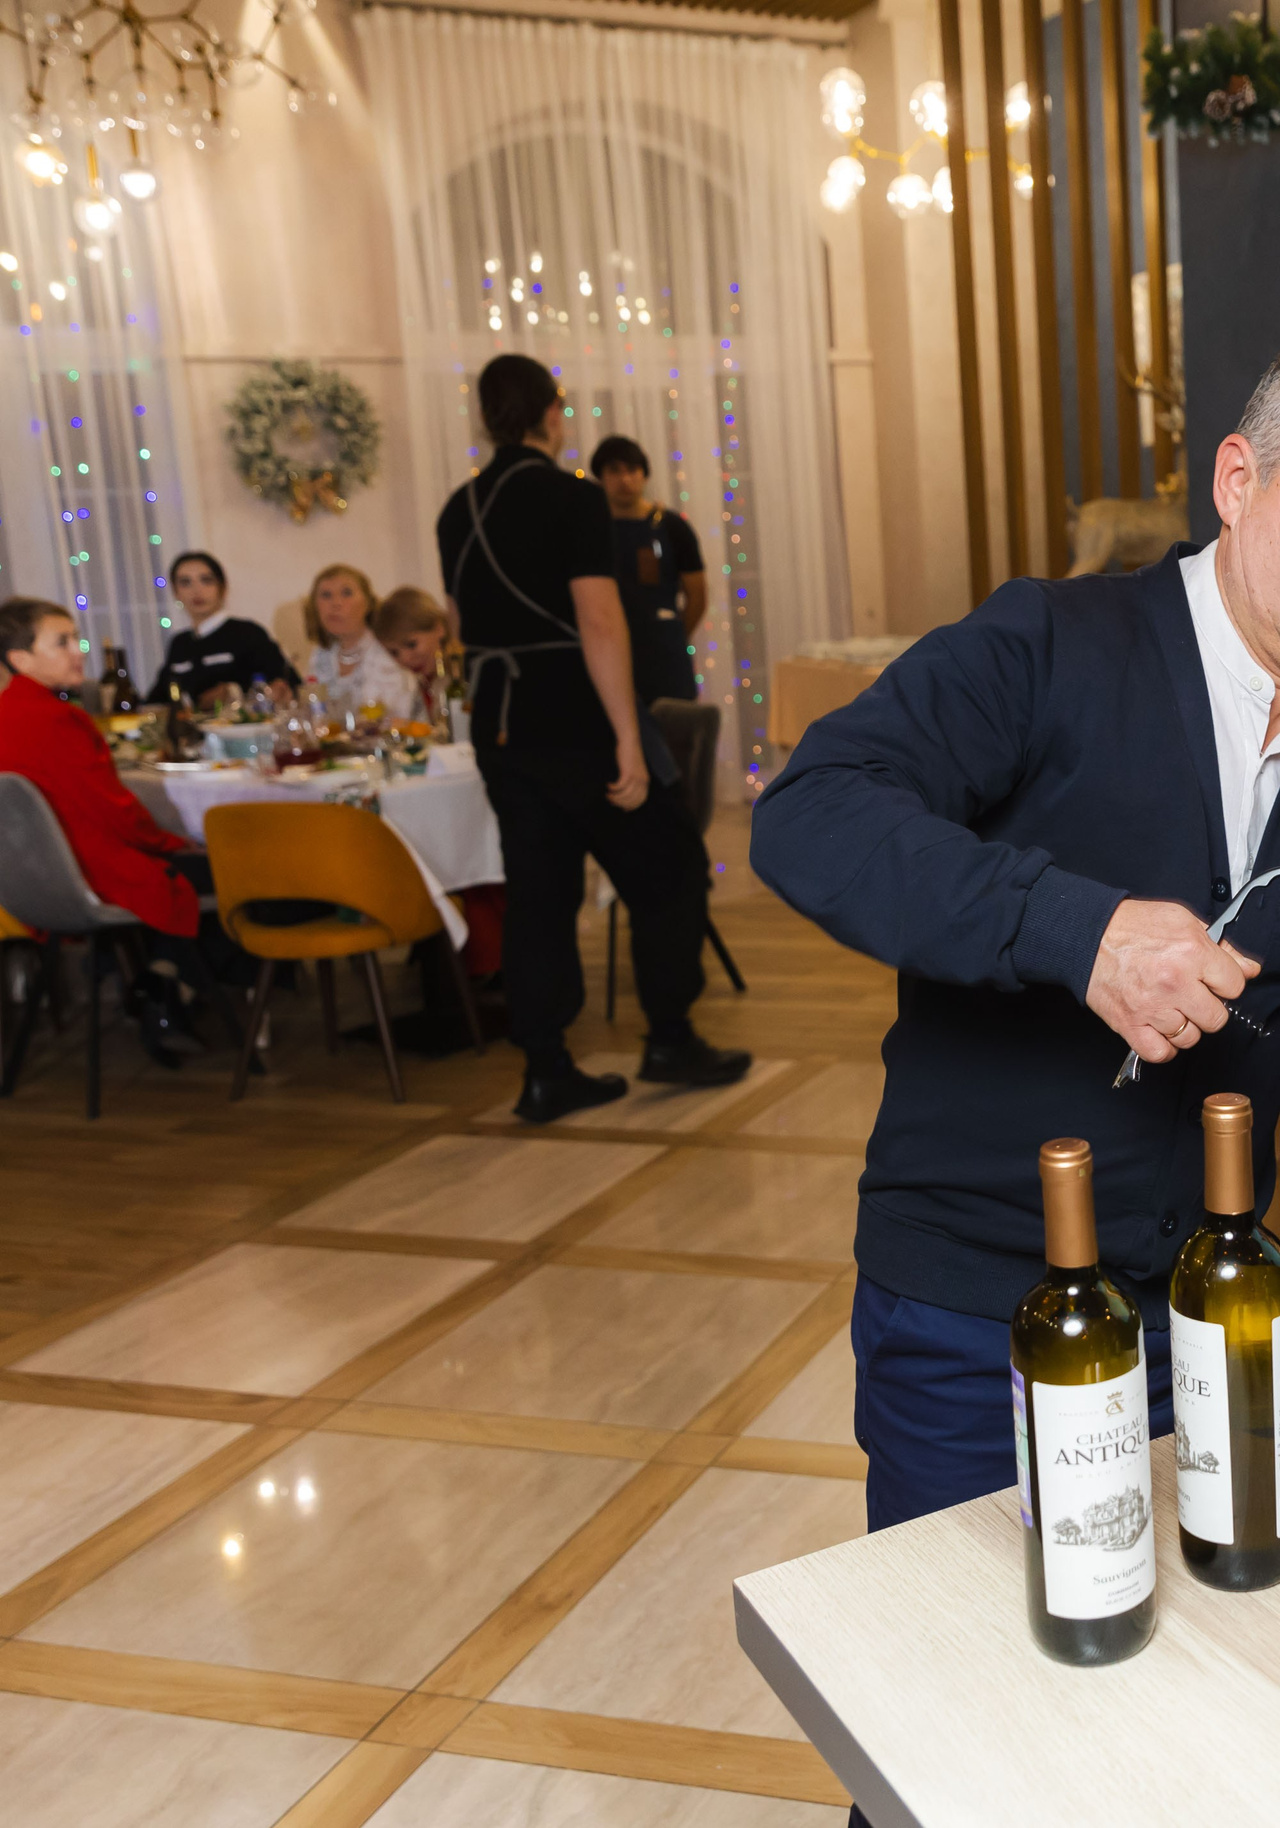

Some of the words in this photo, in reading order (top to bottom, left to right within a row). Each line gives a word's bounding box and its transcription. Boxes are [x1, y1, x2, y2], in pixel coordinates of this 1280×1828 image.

[1054, 1420, 1149, 1466] ANTIQU
[1075, 1412, 1143, 1447] CHATEAU
[1093, 1558, 1147, 1586] Sauvignon
